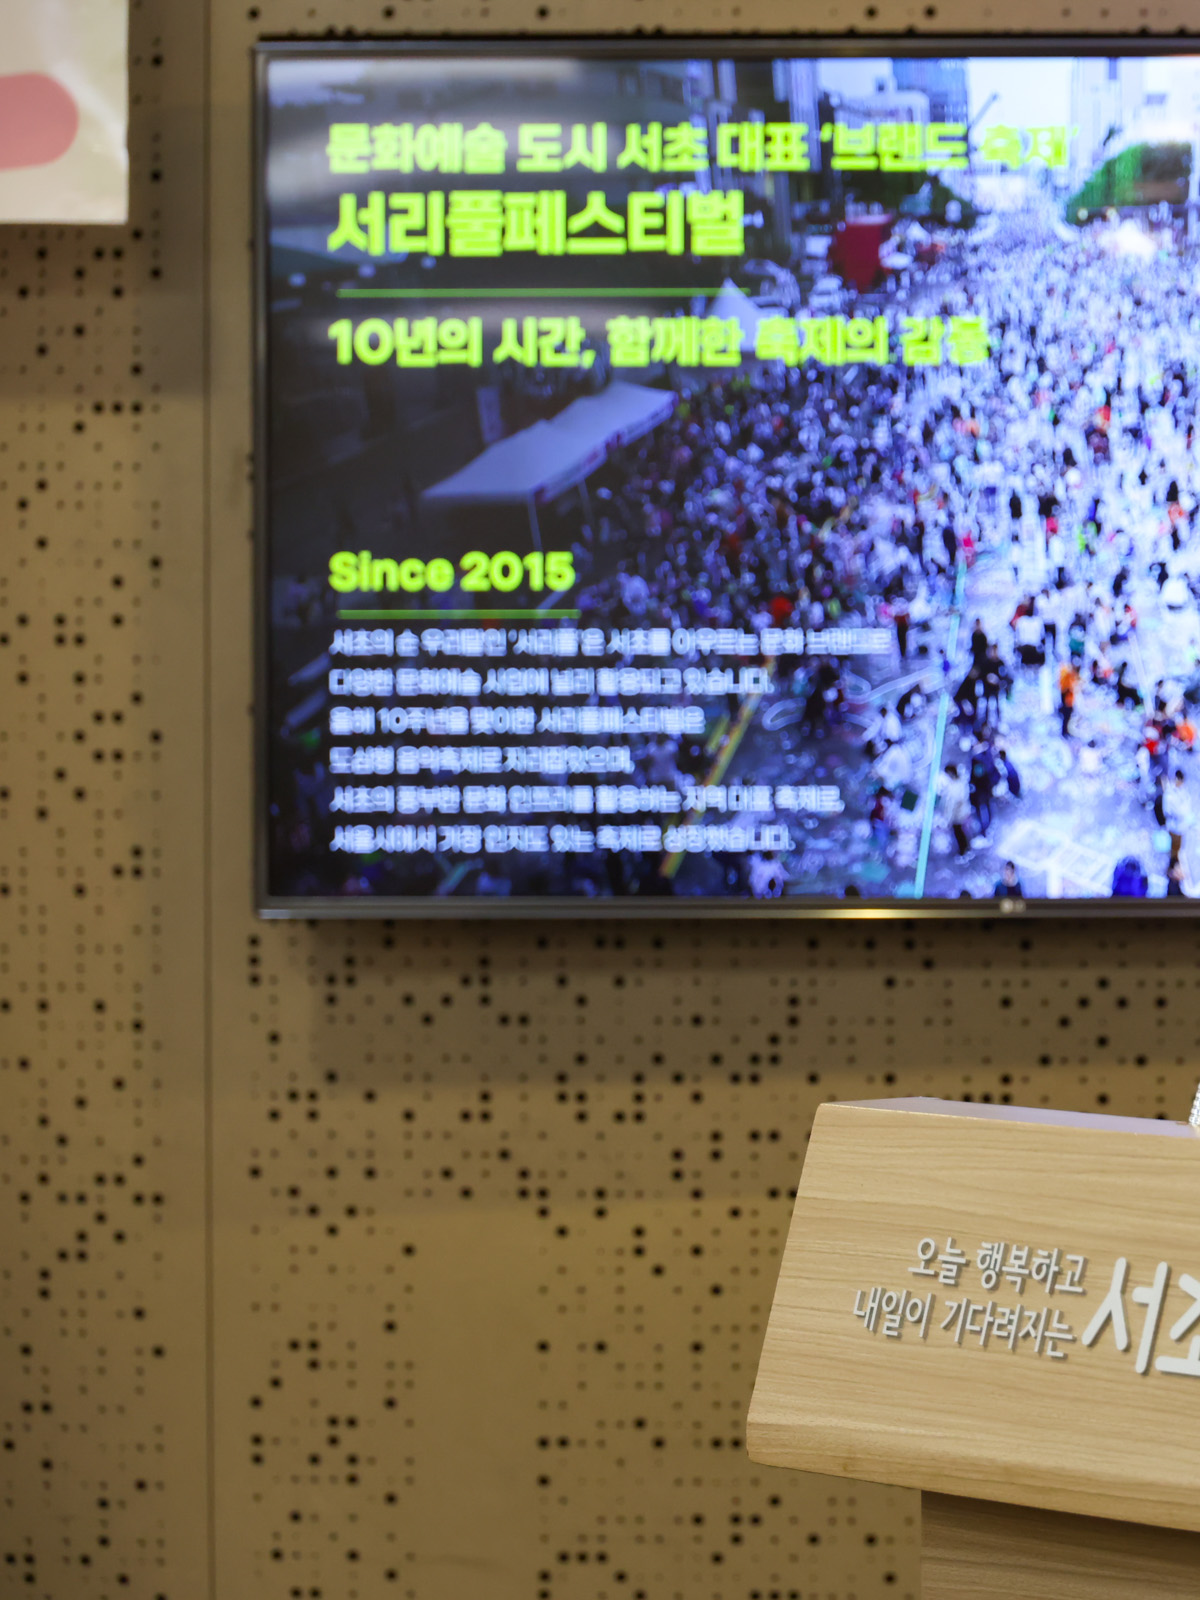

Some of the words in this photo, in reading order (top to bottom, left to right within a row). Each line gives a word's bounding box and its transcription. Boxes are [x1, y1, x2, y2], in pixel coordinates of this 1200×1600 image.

[326, 122, 508, 174] 문화예술
[516, 122, 607, 173] 도시
[616, 122, 710, 172] 서초
[716, 122, 810, 172] 대표
[327, 190, 745, 257] 서리풀페스티벌
[327, 316, 483, 367] 10년의
[492, 316, 596, 369] 시간,
[605, 315, 744, 367] 함께한
[755, 315, 889, 367] 축제의
[901, 315, 990, 367] 감동
[329, 550, 455, 592] Since
[459, 550, 576, 592] 2015
[908, 1237, 970, 1285] 오늘
[976, 1242, 1087, 1294] 행복하고
[853, 1287, 935, 1339] 내일이
[940, 1297, 1076, 1358] 기다려지는
